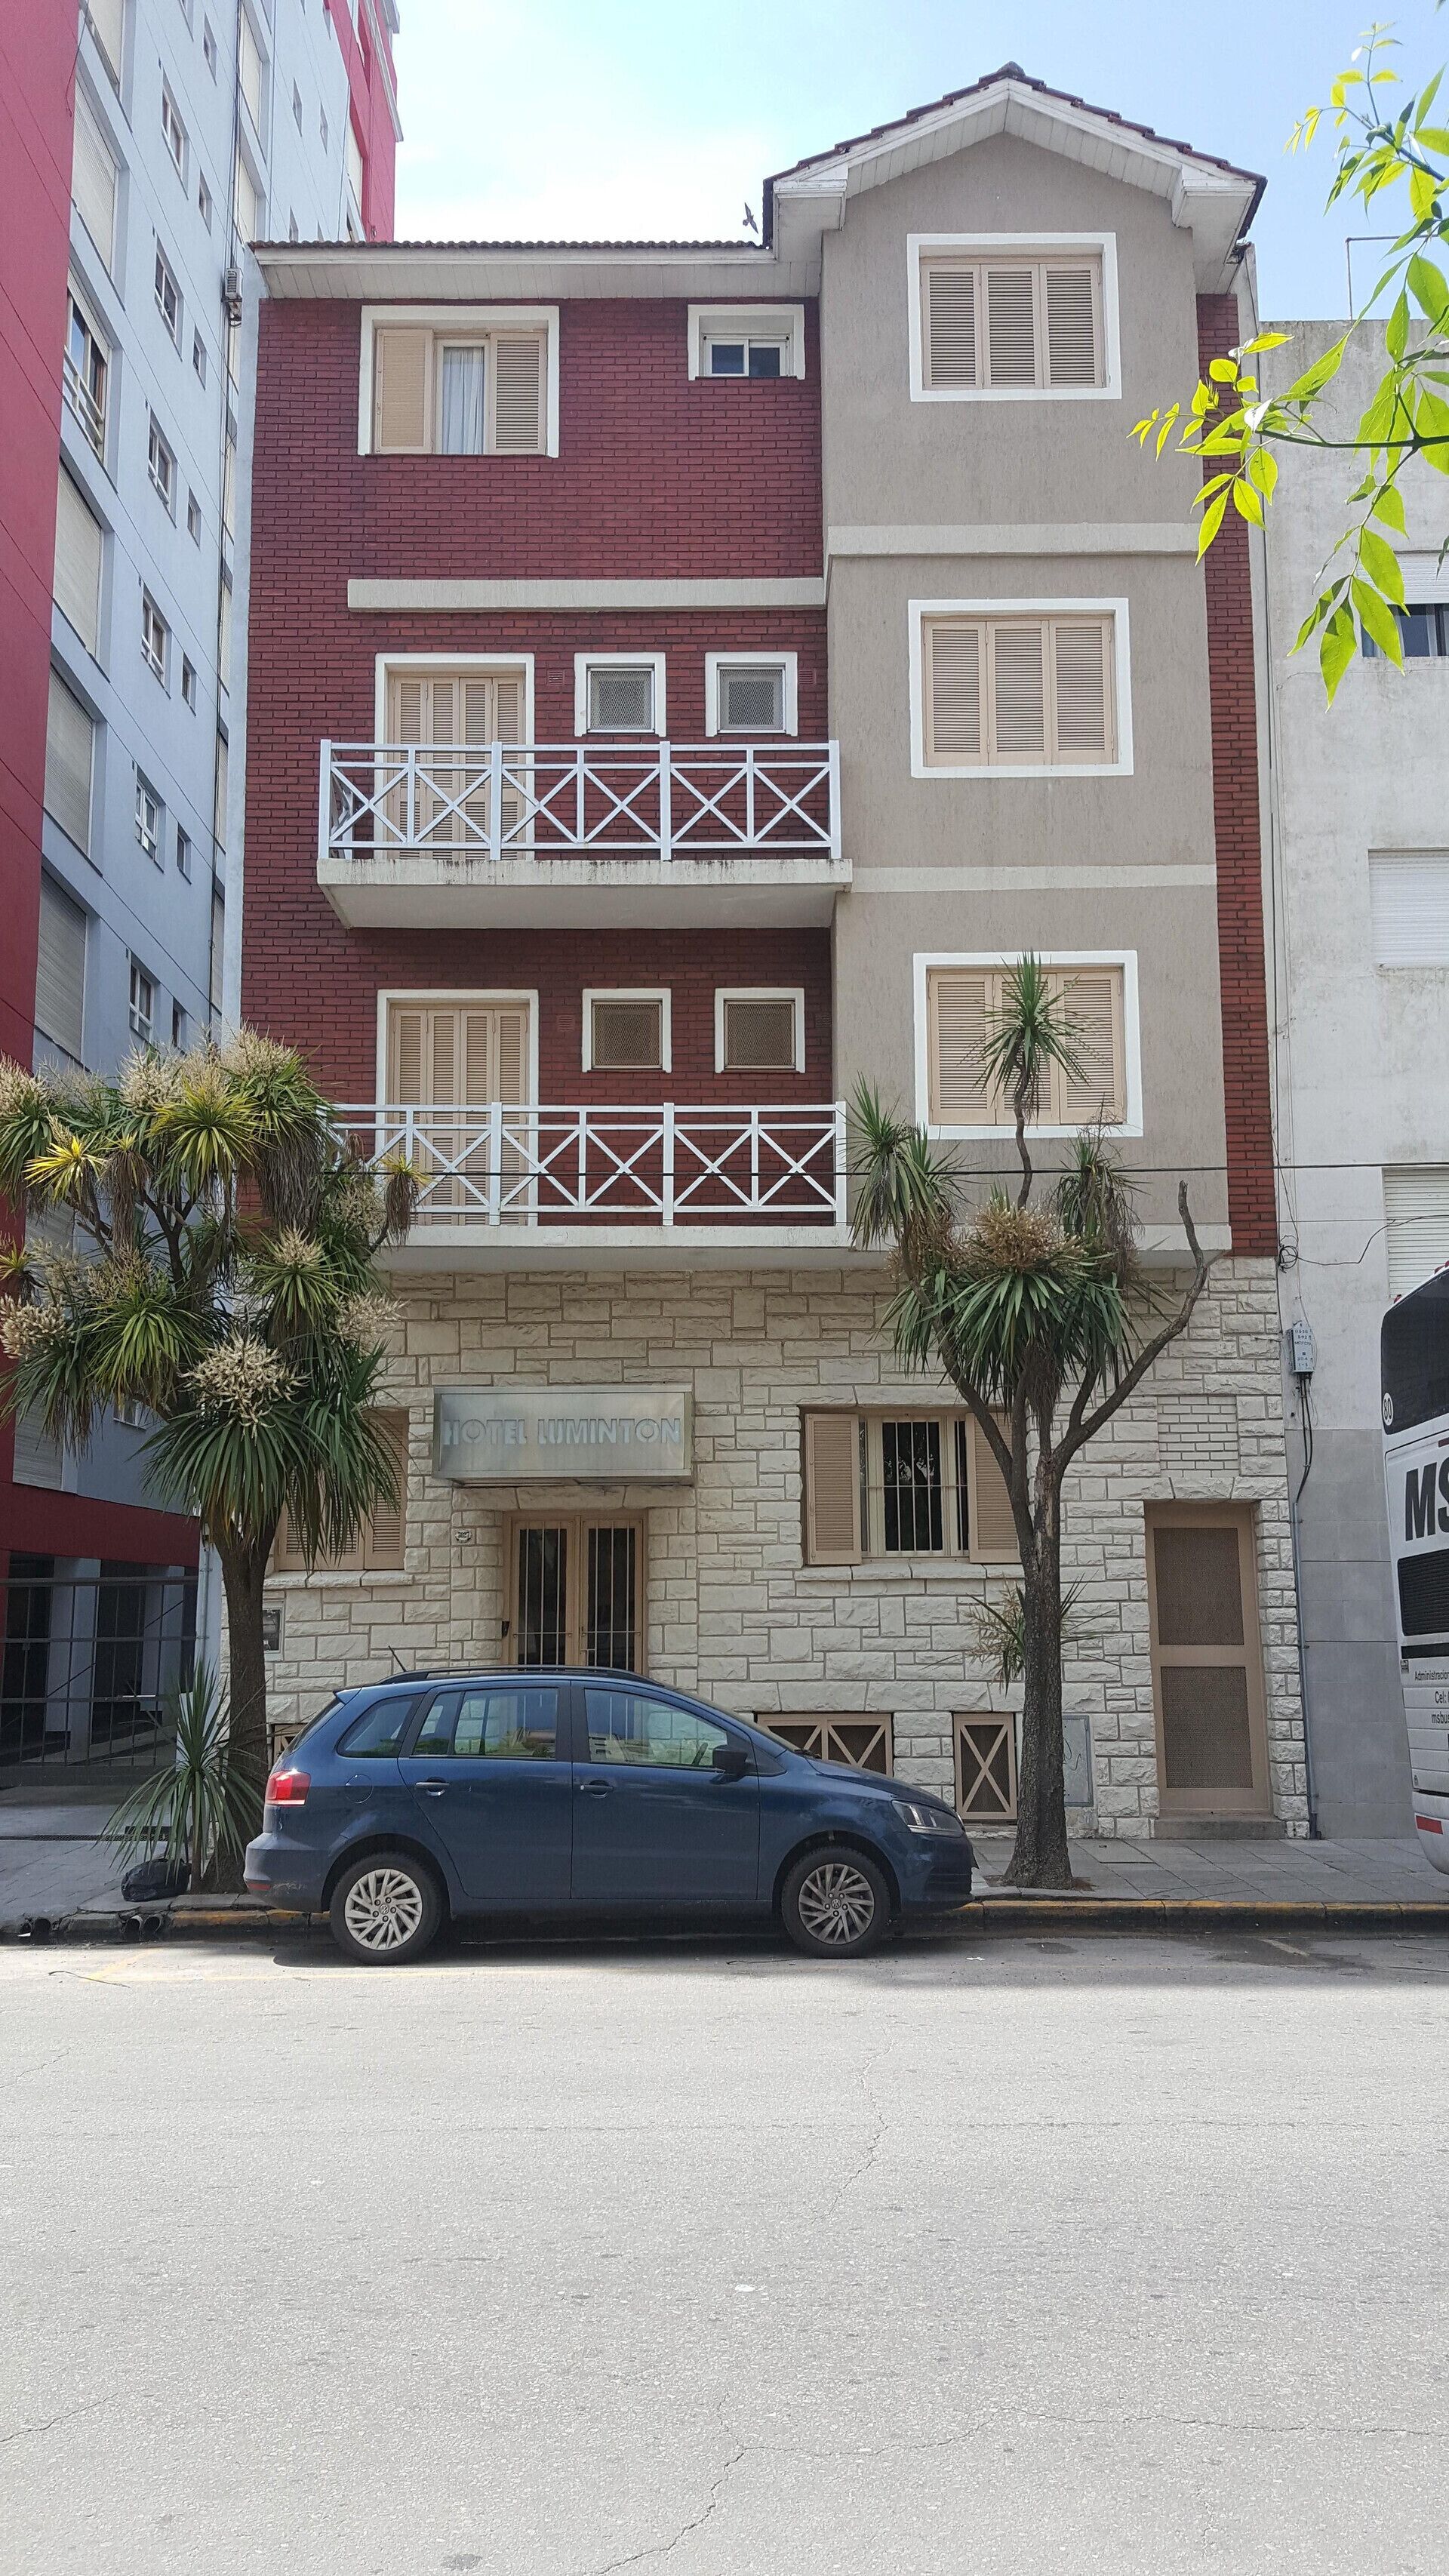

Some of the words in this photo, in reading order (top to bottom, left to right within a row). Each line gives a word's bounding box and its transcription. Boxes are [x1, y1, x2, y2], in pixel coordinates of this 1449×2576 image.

[1384, 1398, 1392, 1420] 80
[443, 1418, 527, 1445] HOTEL
[538, 1418, 680, 1444] LUMINTON
